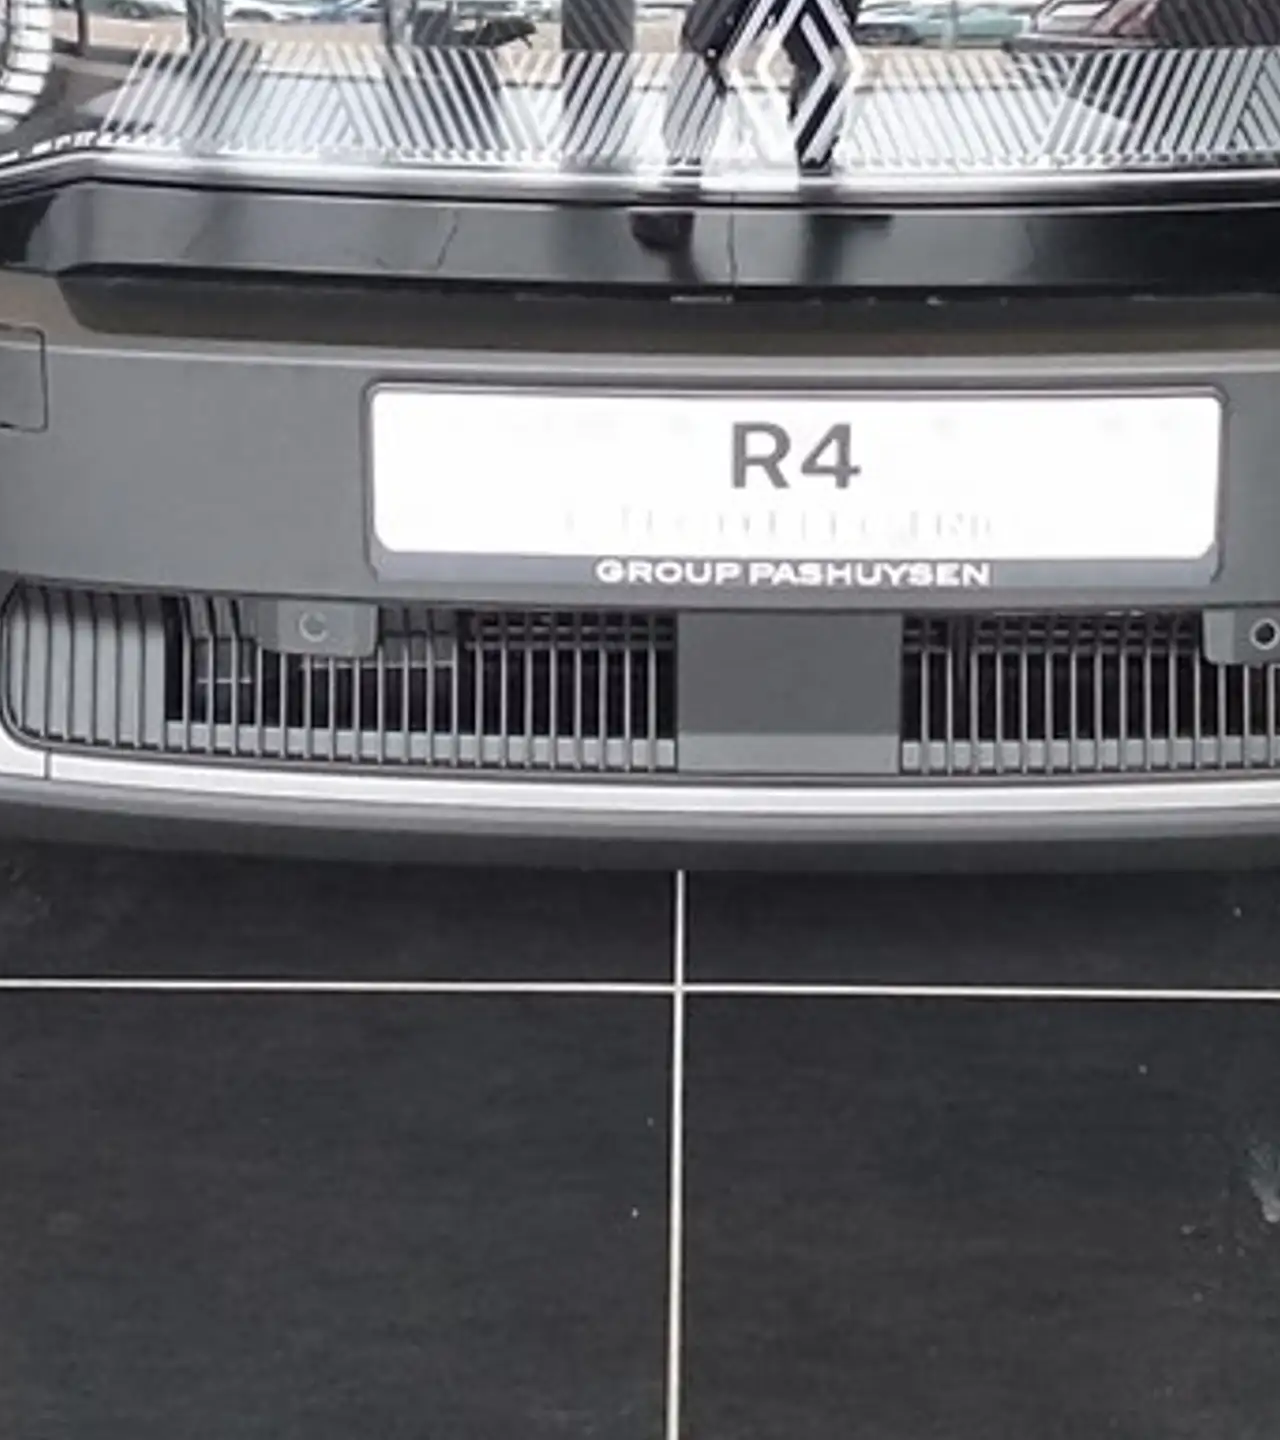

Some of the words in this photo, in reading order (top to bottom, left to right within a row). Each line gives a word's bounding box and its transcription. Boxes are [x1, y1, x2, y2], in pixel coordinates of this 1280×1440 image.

[731, 421, 862, 490] R4
[594, 559, 742, 587] GROUP
[747, 561, 992, 589] PASHUYSEN
